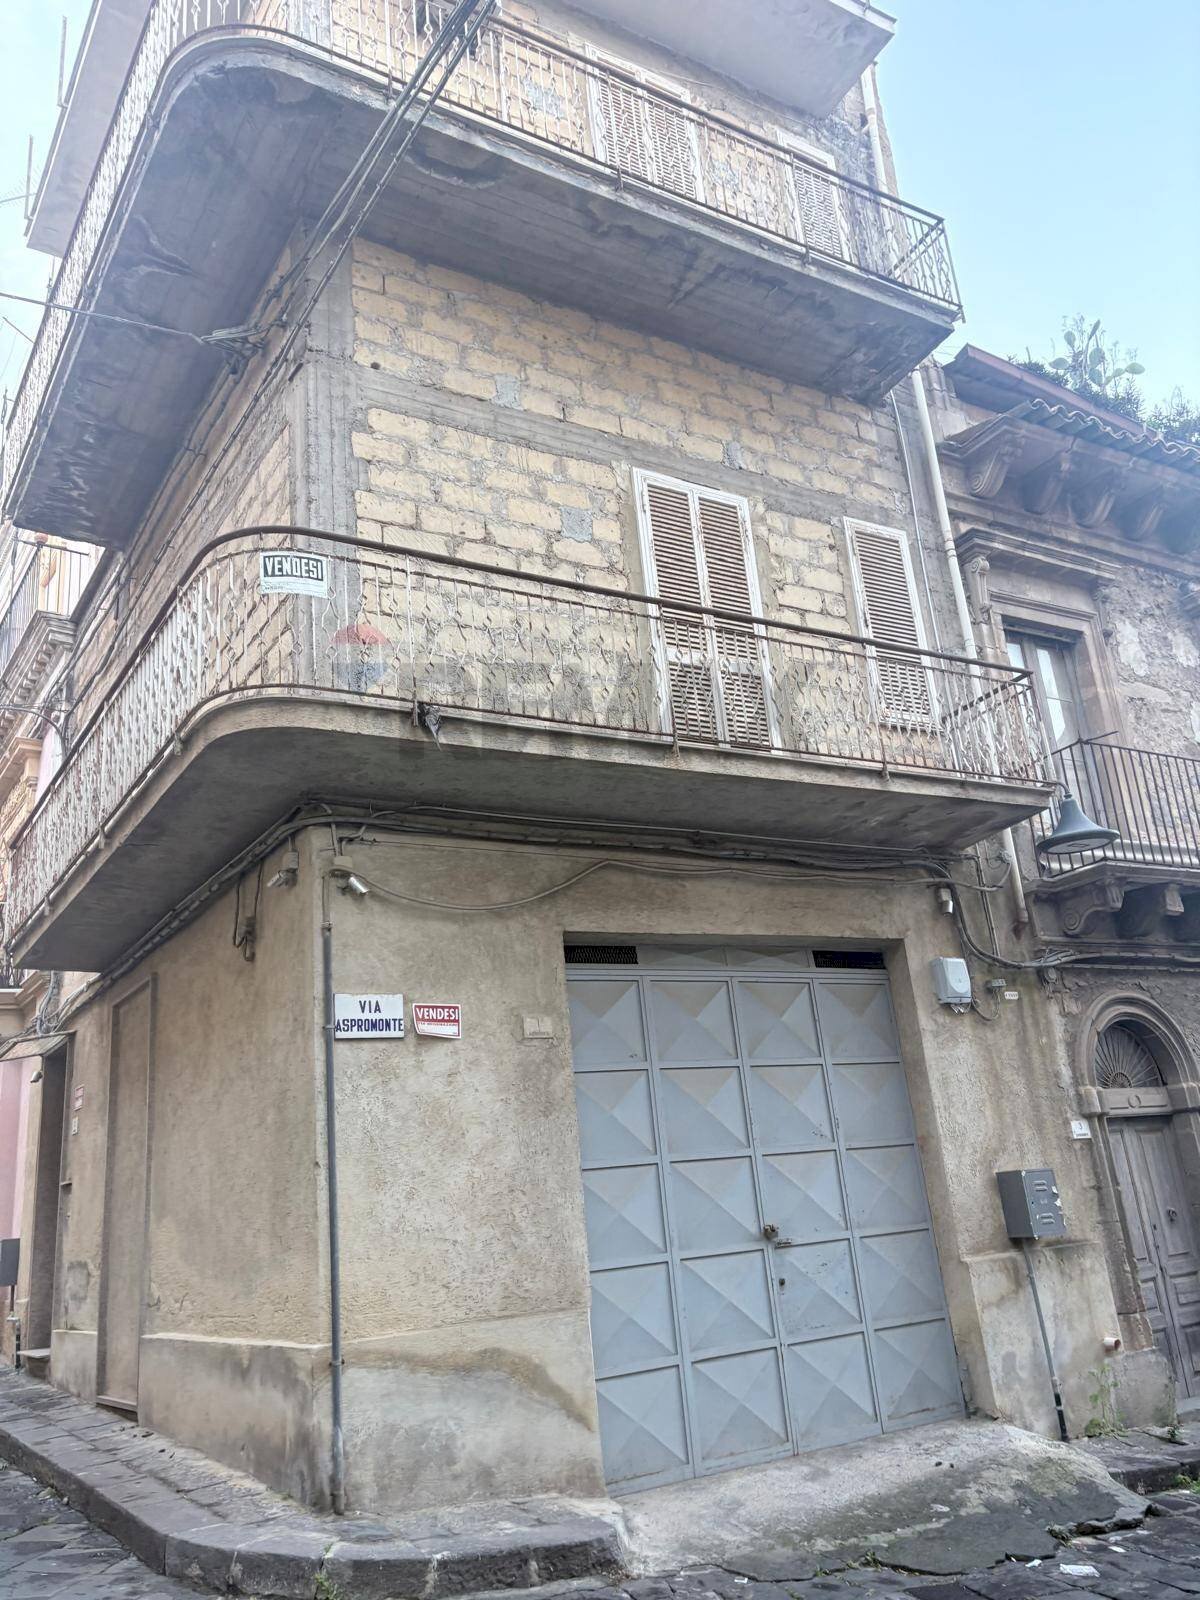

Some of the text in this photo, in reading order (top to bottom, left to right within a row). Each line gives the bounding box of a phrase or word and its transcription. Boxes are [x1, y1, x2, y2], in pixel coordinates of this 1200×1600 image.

[264, 556, 322, 580] VENDESI
[358, 1000, 382, 1014] VIA
[416, 1007, 459, 1020] VENDESI
[335, 1018, 404, 1032] ASPROMONTE
